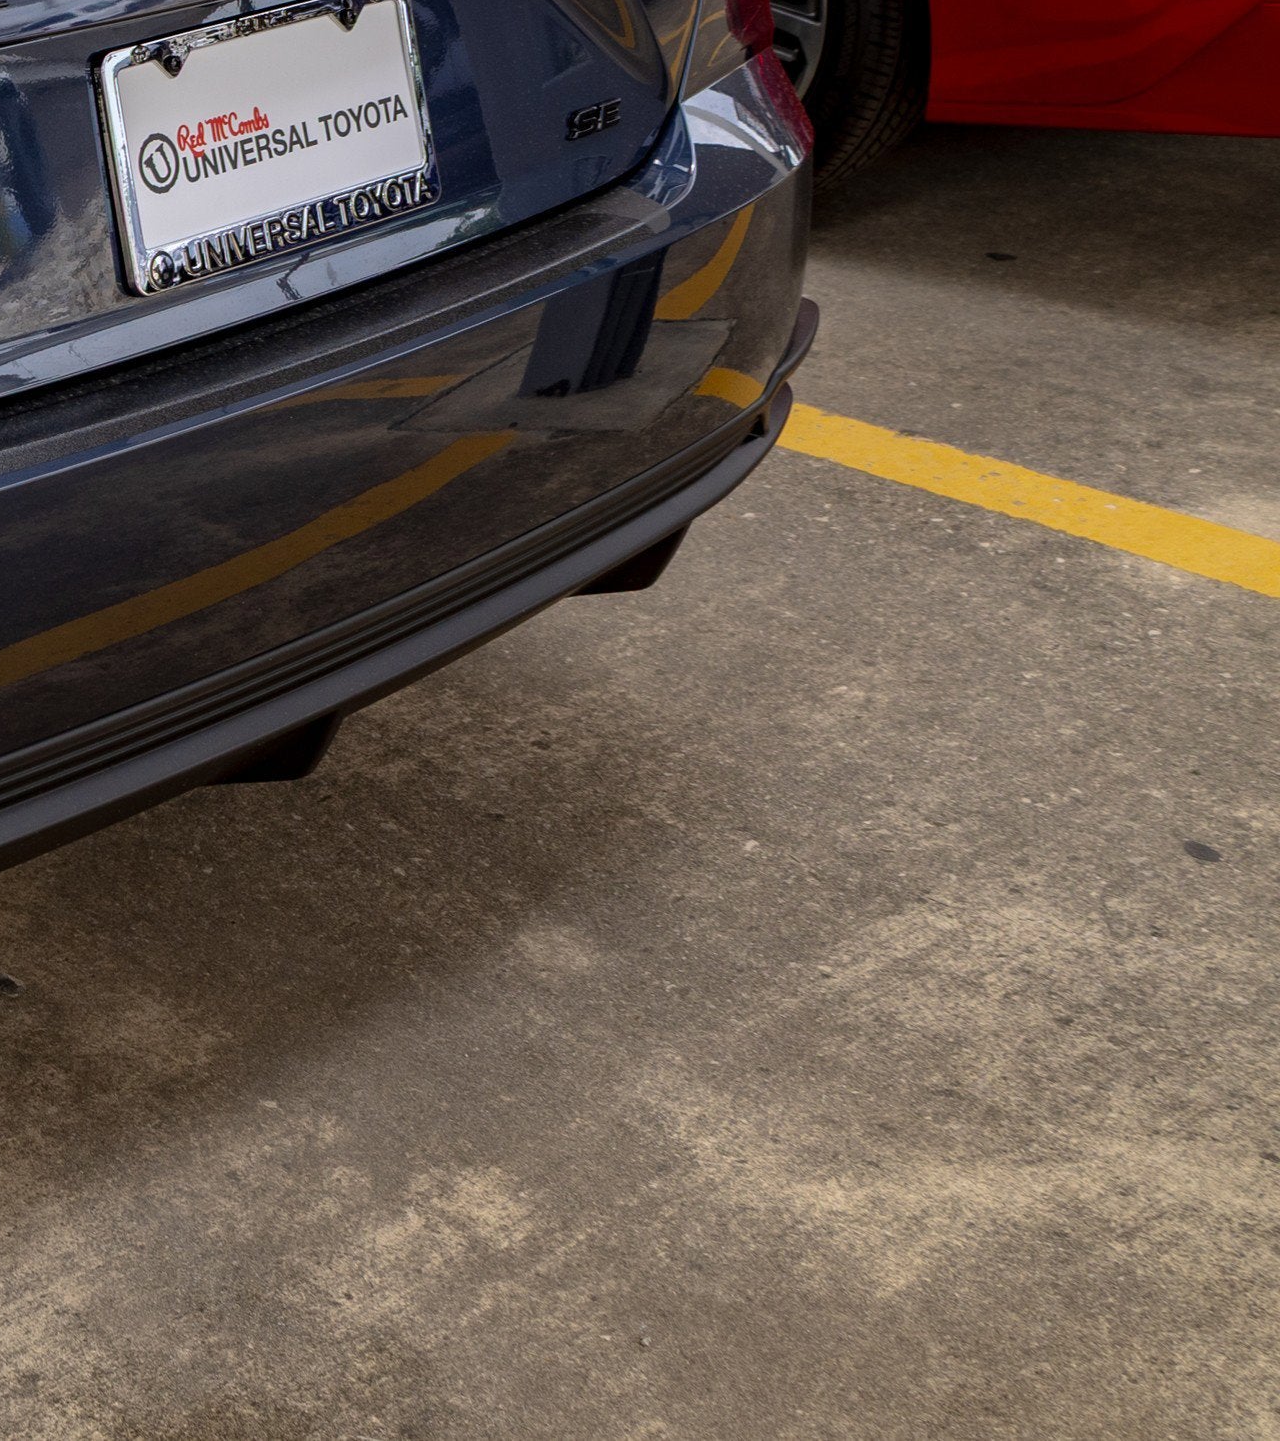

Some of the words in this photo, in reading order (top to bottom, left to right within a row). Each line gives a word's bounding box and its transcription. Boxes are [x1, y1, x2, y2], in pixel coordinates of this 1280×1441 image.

[177, 123, 206, 158] Red
[208, 106, 270, 145] McCombs
[182, 128, 318, 184] UNIVERSAL
[318, 94, 409, 143] TOYOTA
[566, 97, 622, 142] SE
[181, 201, 336, 277] UNIVERSAL
[332, 170, 433, 227] TOYOTA
